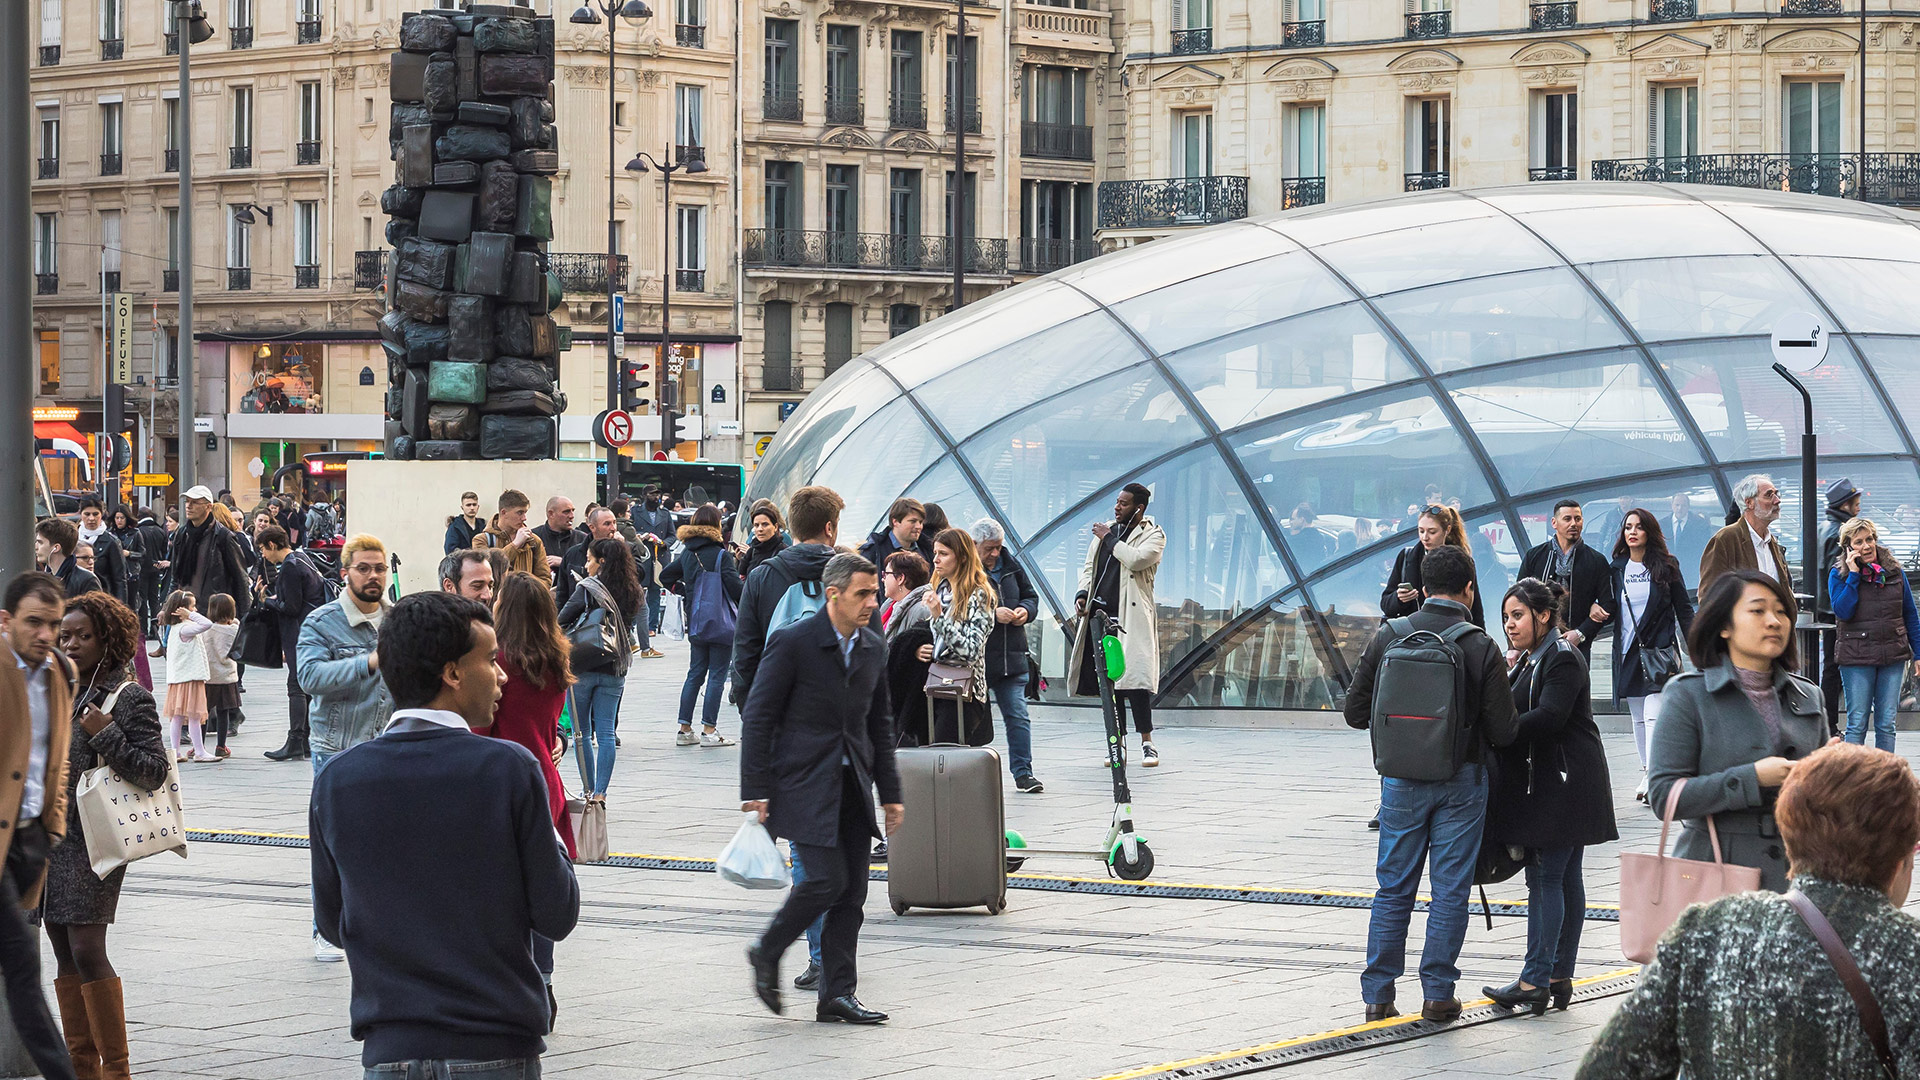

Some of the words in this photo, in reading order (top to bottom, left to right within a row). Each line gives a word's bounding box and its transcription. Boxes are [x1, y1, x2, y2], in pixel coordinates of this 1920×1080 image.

[617, 302, 623, 327] P
[119, 297, 128, 380] COIFFURE
[1624, 431, 1661, 441] véhicule
